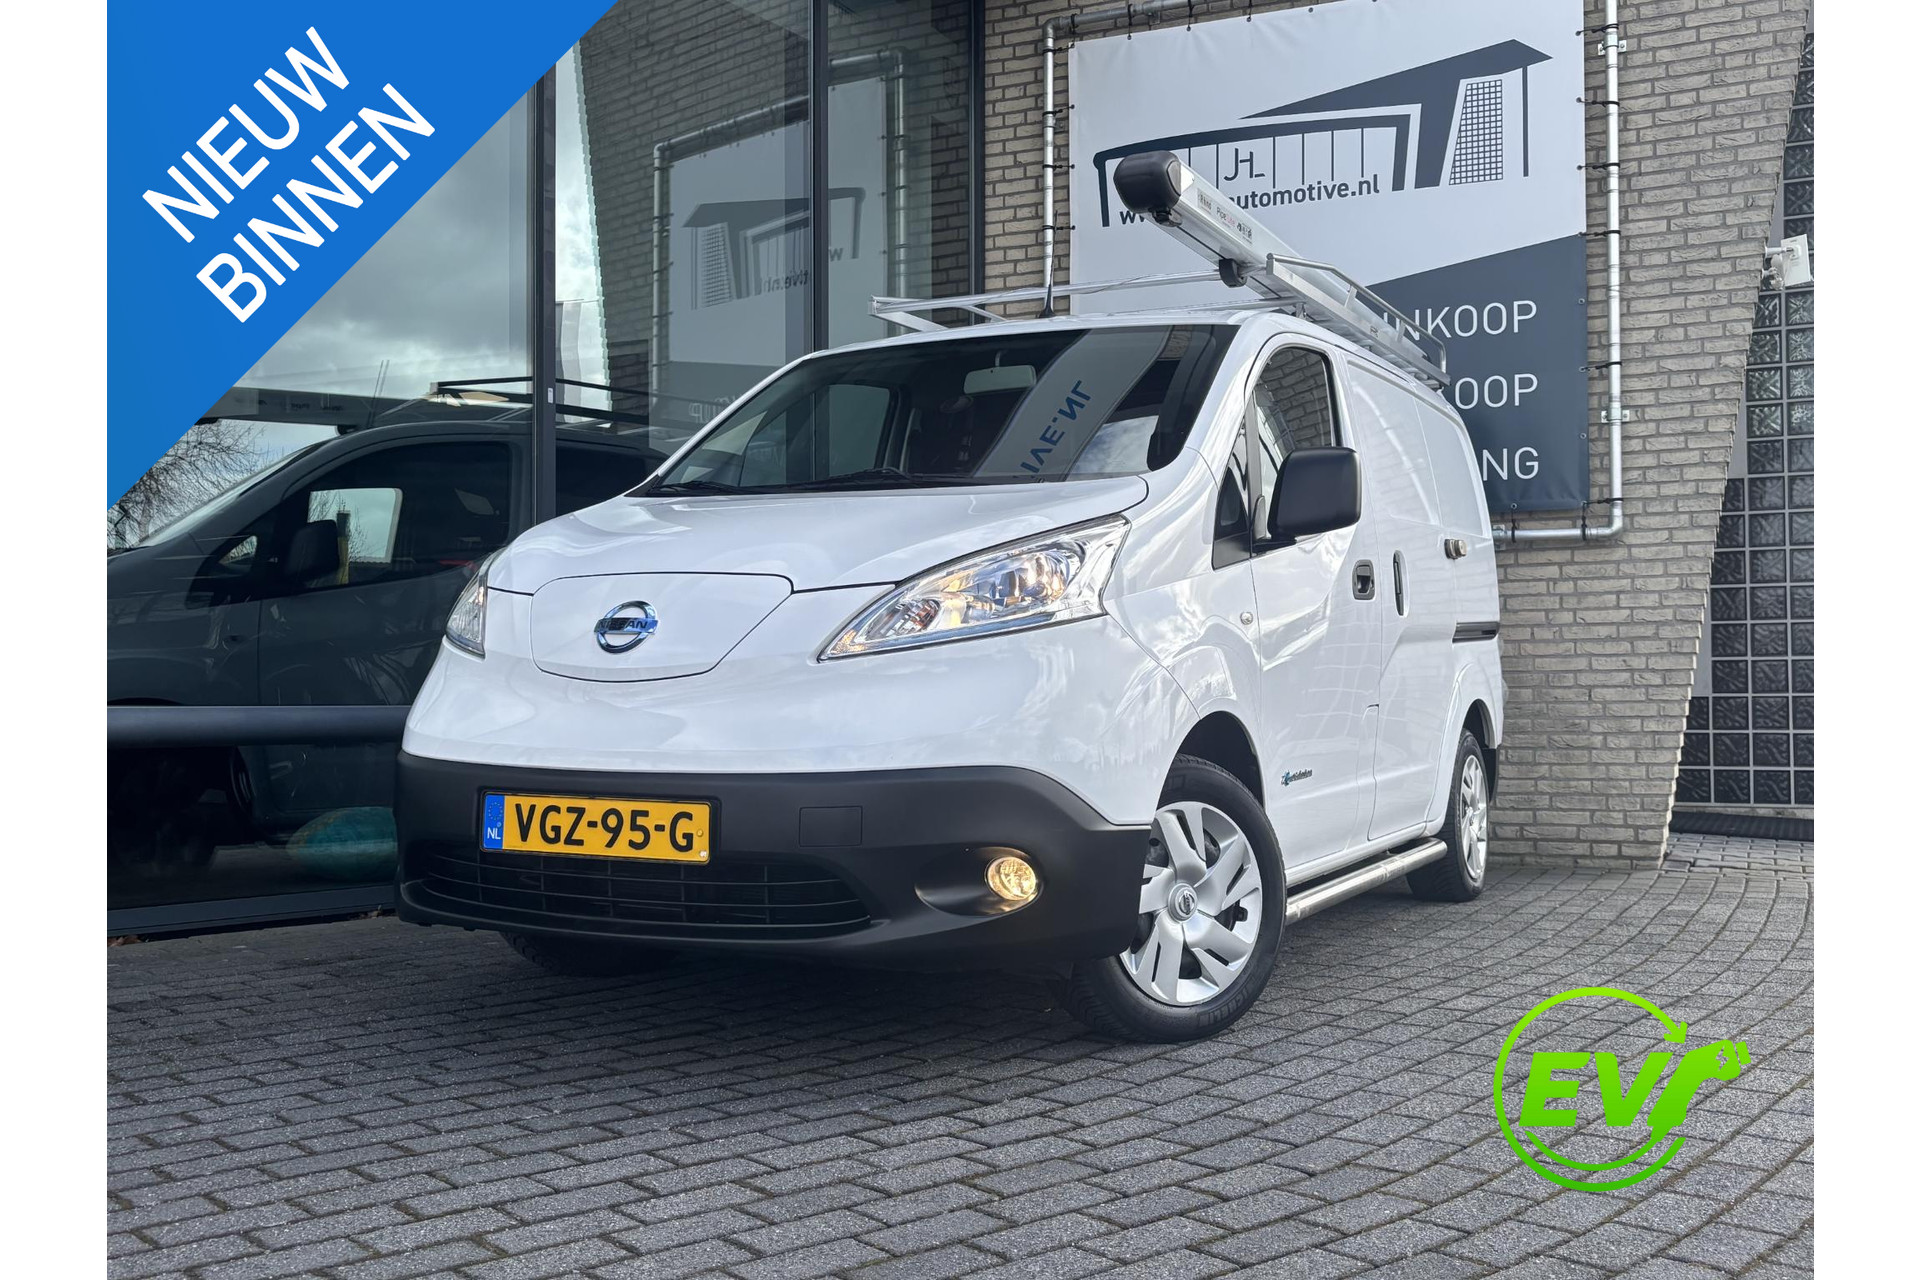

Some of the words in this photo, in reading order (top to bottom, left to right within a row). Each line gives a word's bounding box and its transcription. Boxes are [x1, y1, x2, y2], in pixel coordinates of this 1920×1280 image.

[1438, 373, 1538, 410] OOP
[598, 619, 649, 631] NISSAN
[487, 826, 501, 840] NL
[514, 802, 695, 853] VGZ-95-G
